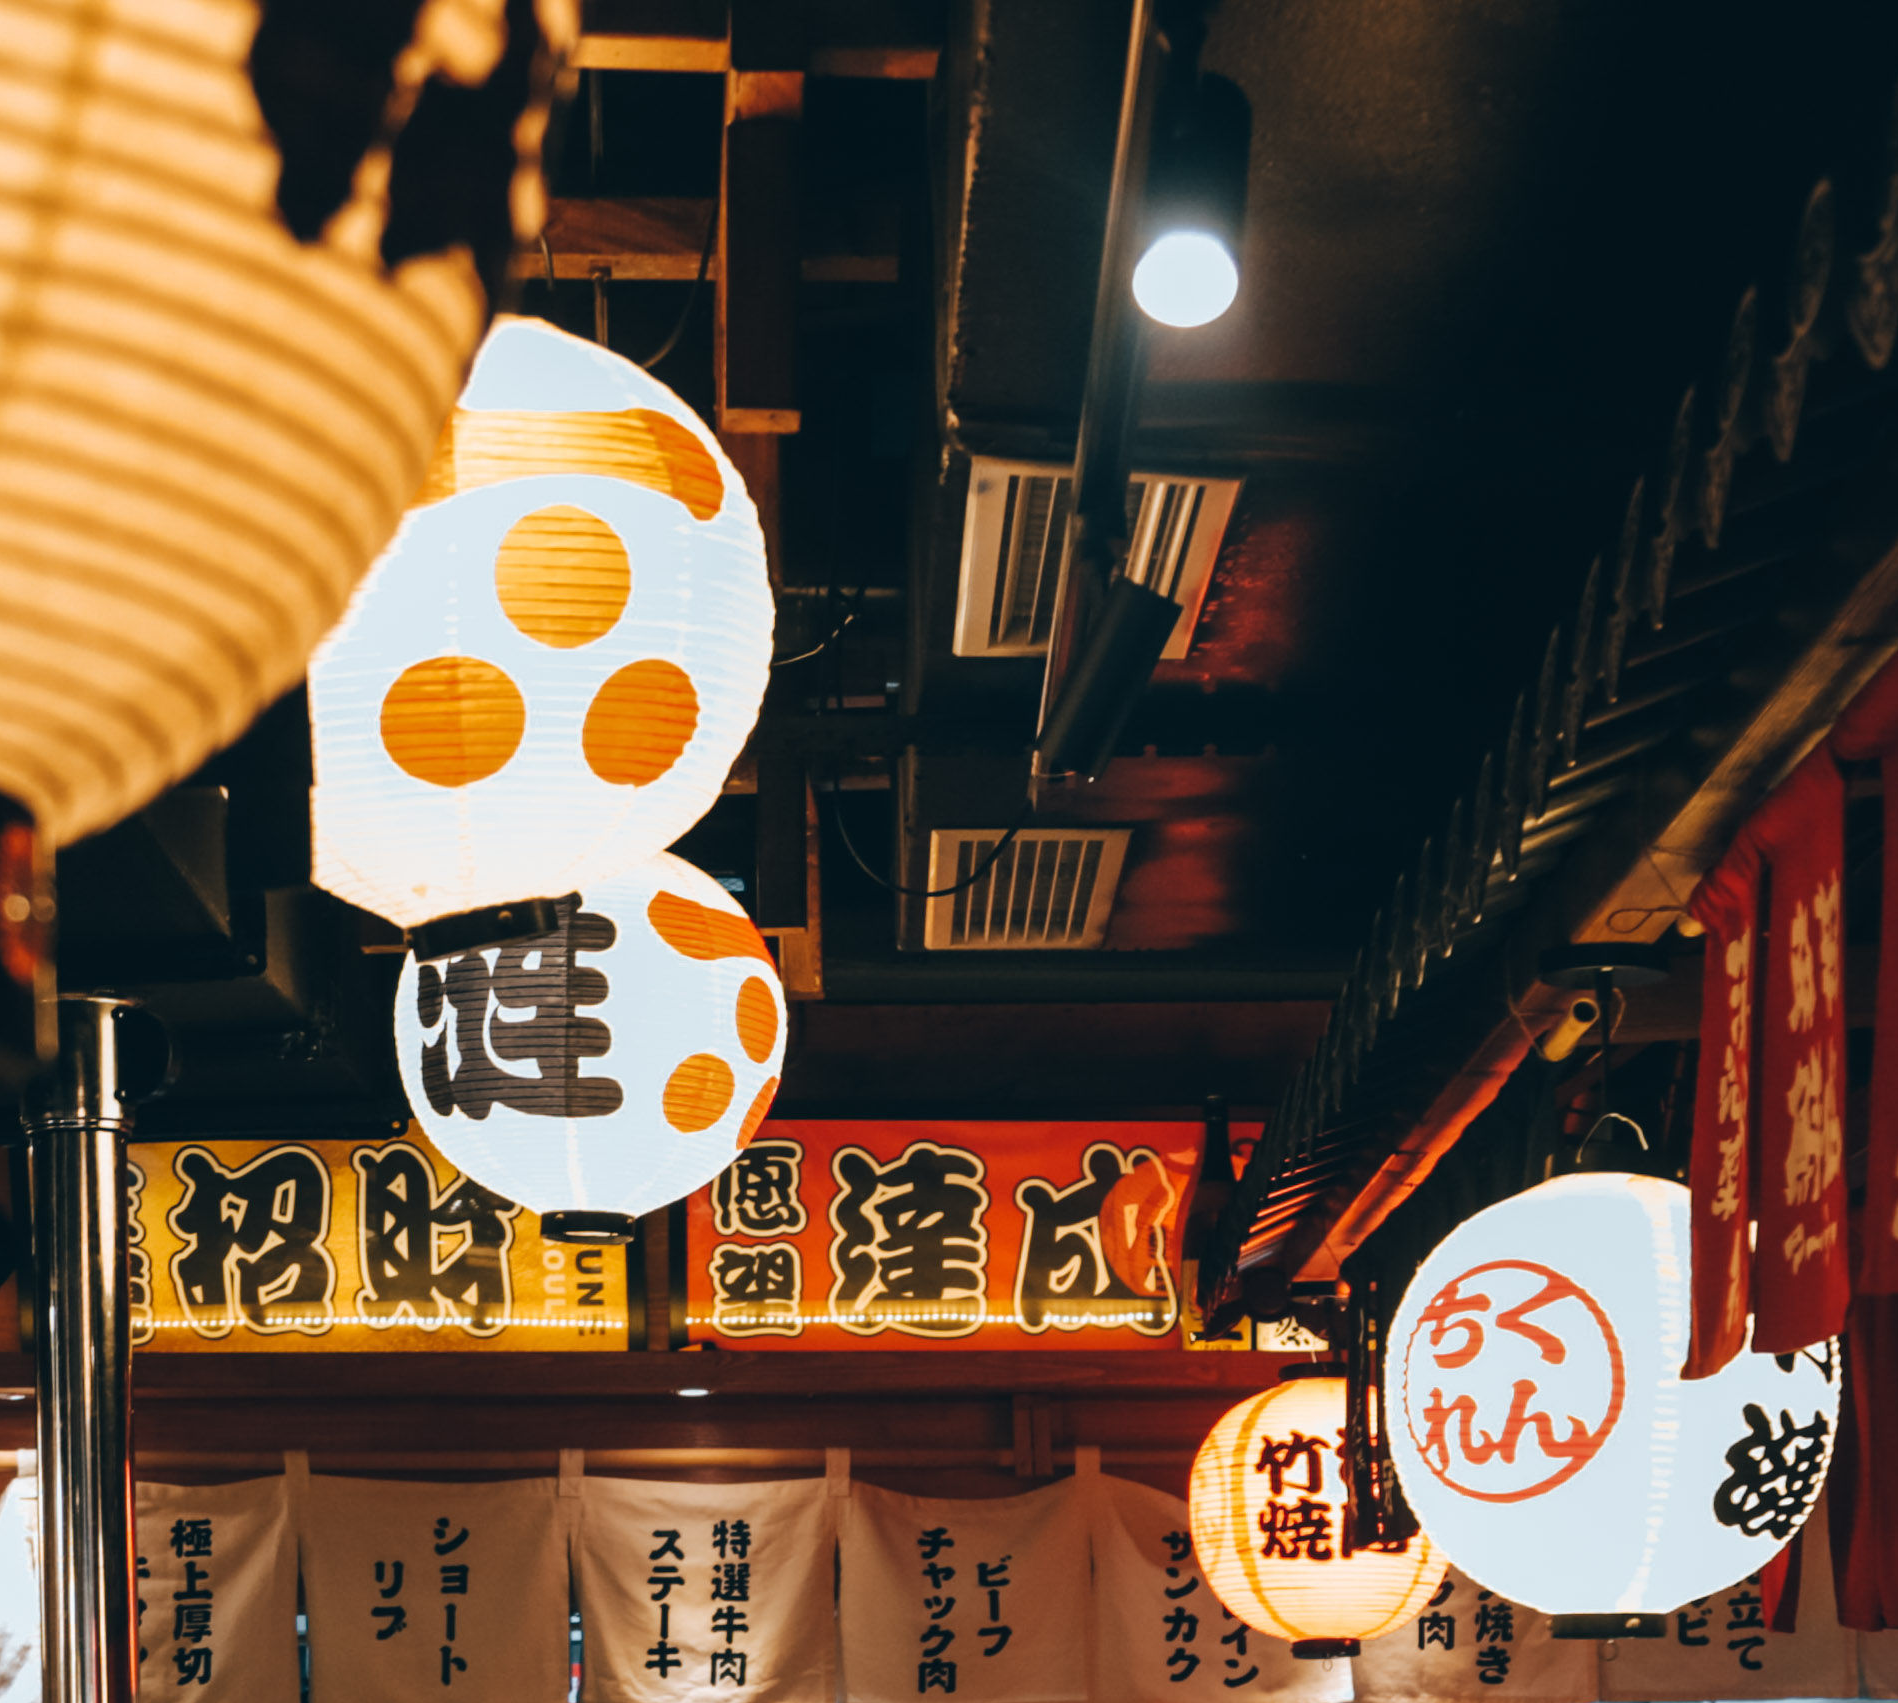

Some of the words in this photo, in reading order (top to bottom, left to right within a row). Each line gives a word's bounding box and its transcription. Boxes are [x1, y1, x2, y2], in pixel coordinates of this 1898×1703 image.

[170, 1518, 213, 1686] 極上厚切
[370, 1560, 408, 1641] リブ
[433, 1517, 470, 1686] ショート
[645, 1528, 686, 1680] ステーキ
[709, 1519, 753, 1688] 特選牛肉
[917, 1527, 958, 1695] チャック肉
[976, 1554, 1014, 1658] ビーフ
[1161, 1531, 1201, 1683] サンカク
[1475, 1590, 1513, 1685] 焼き
[1727, 1577, 1766, 1671] 立て
